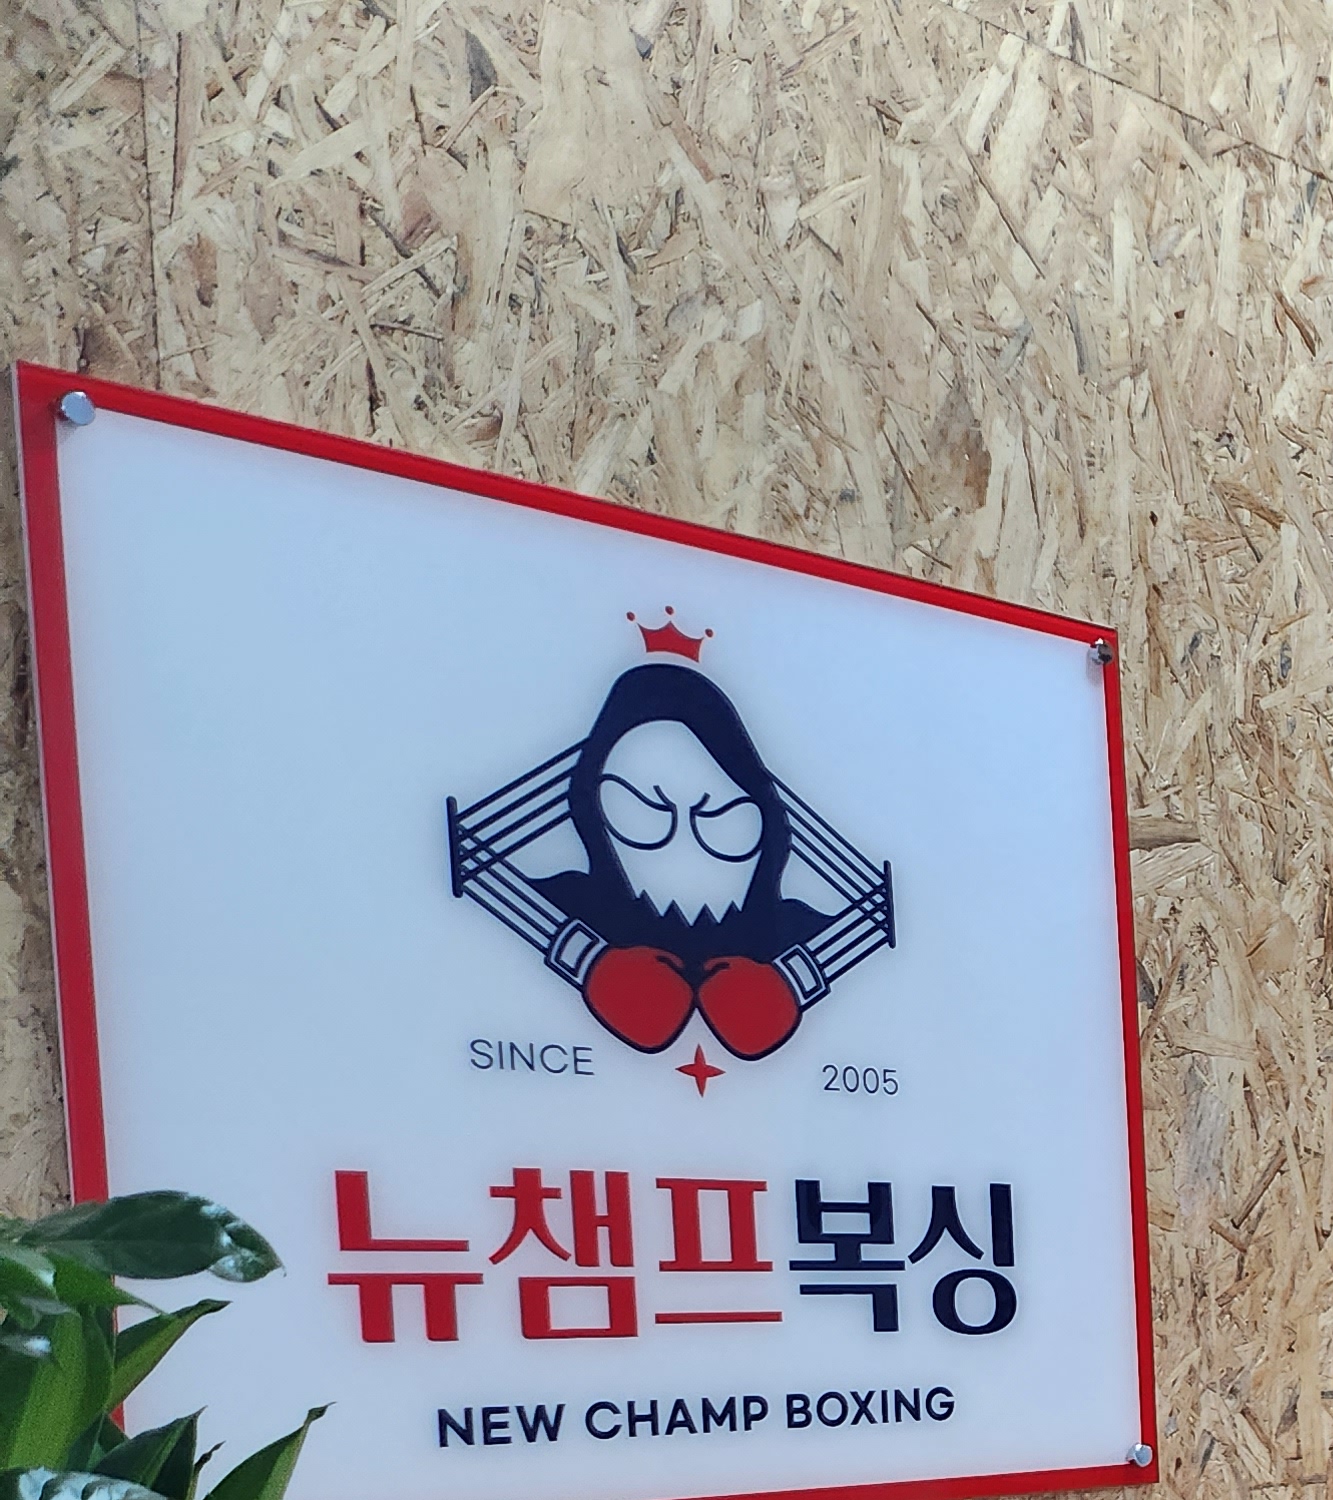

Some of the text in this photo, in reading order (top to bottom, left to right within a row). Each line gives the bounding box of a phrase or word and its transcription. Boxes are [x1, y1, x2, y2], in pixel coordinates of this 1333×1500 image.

[469, 1037, 596, 1076] SINCE
[822, 1063, 900, 1097] 2005
[328, 1166, 1019, 1343] 뉴챔프복싱
[438, 1386, 956, 1448] NEW CHAMP BOXING
